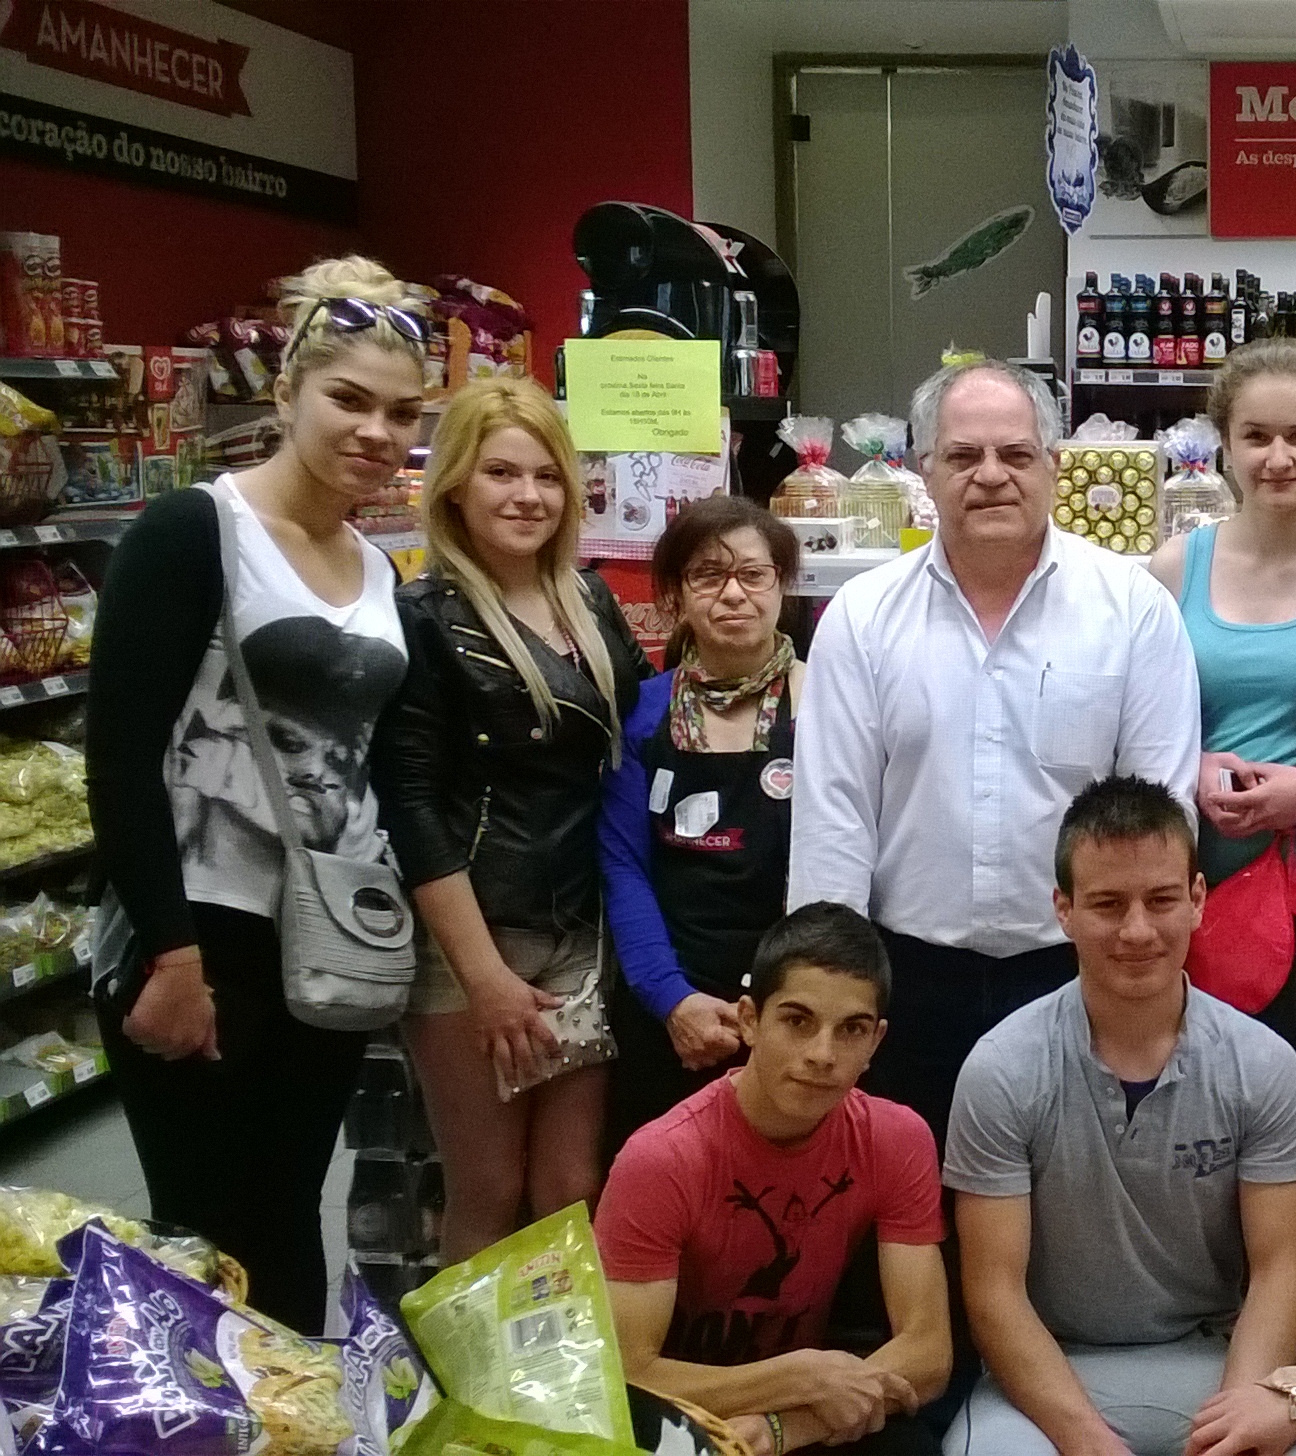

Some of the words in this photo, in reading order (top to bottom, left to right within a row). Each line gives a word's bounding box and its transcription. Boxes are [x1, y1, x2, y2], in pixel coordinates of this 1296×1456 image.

[37, 4, 224, 98] AMANHECER
[113, 132, 146, 167] do
[149, 146, 218, 182] nosso
[221, 156, 288, 198] bairro
[1235, 150, 1258, 165] As
[651, 428, 689, 438] Obrigado
